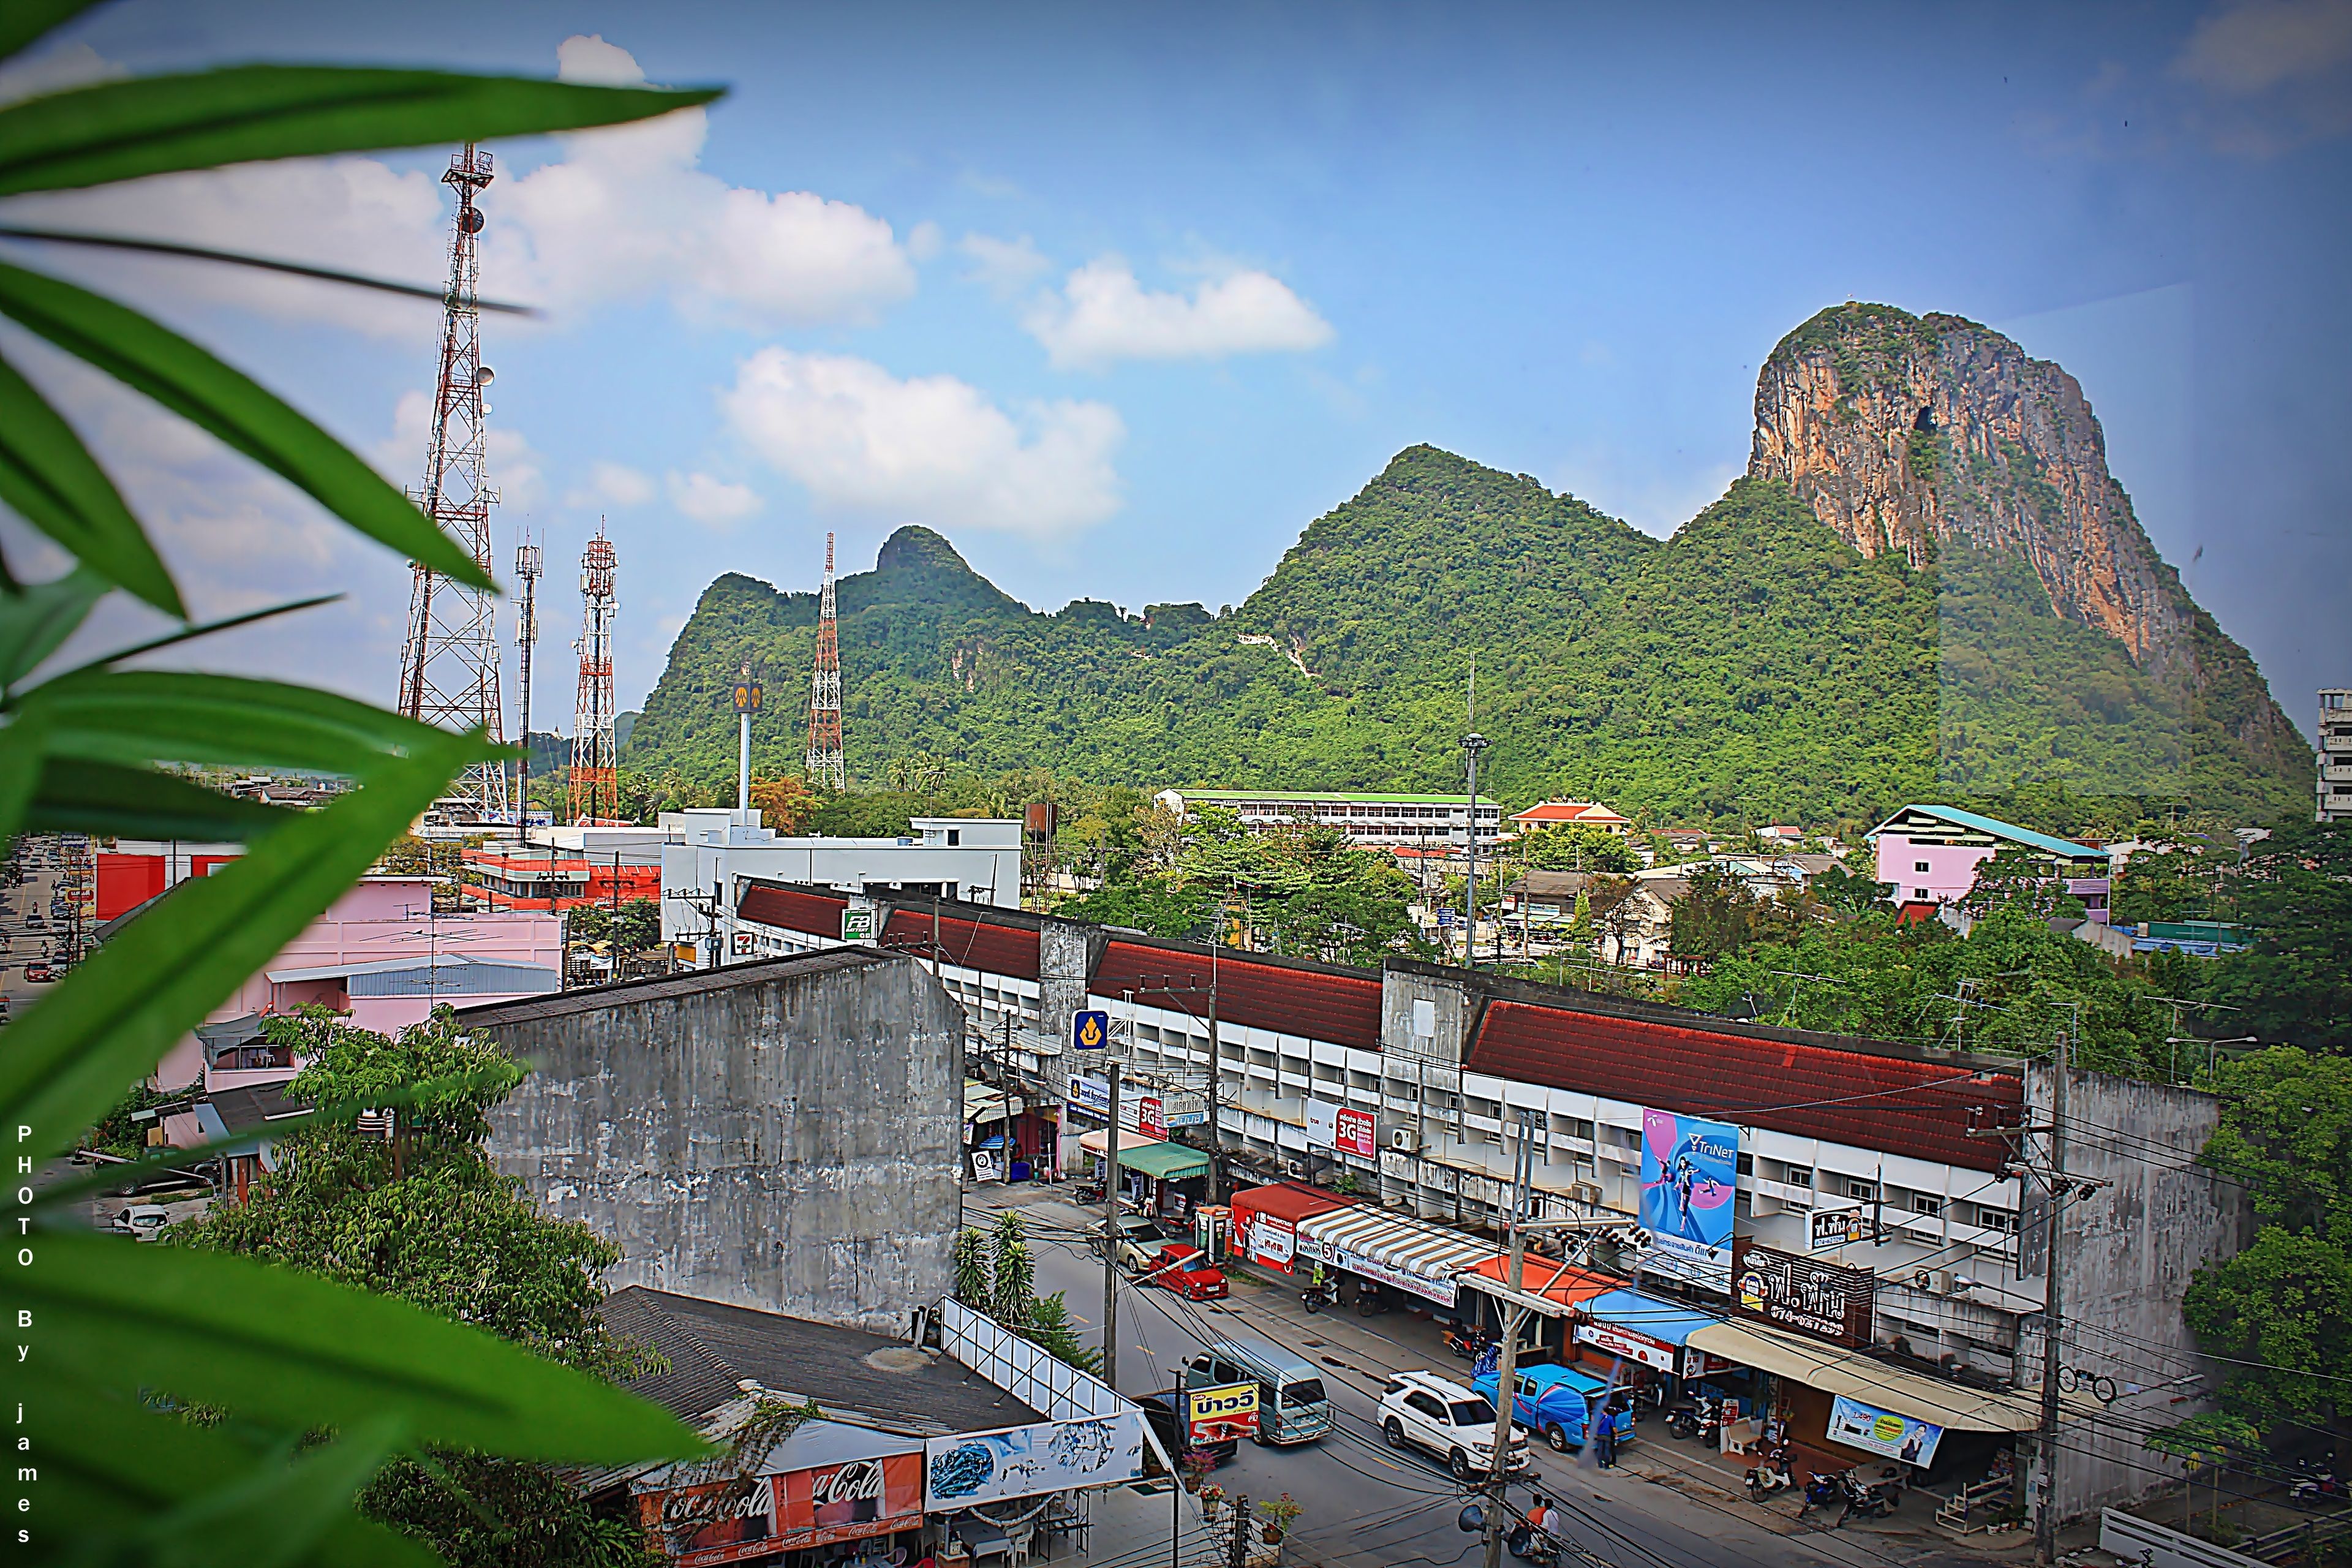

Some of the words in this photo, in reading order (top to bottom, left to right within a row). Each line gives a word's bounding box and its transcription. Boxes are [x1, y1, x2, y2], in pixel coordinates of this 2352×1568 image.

[847, 916, 870, 928] FB
[1141, 1109, 1155, 1125] 3G
[1338, 1121, 1357, 1140] 3G
[1197, 1390, 1254, 1414] บ่าววี
